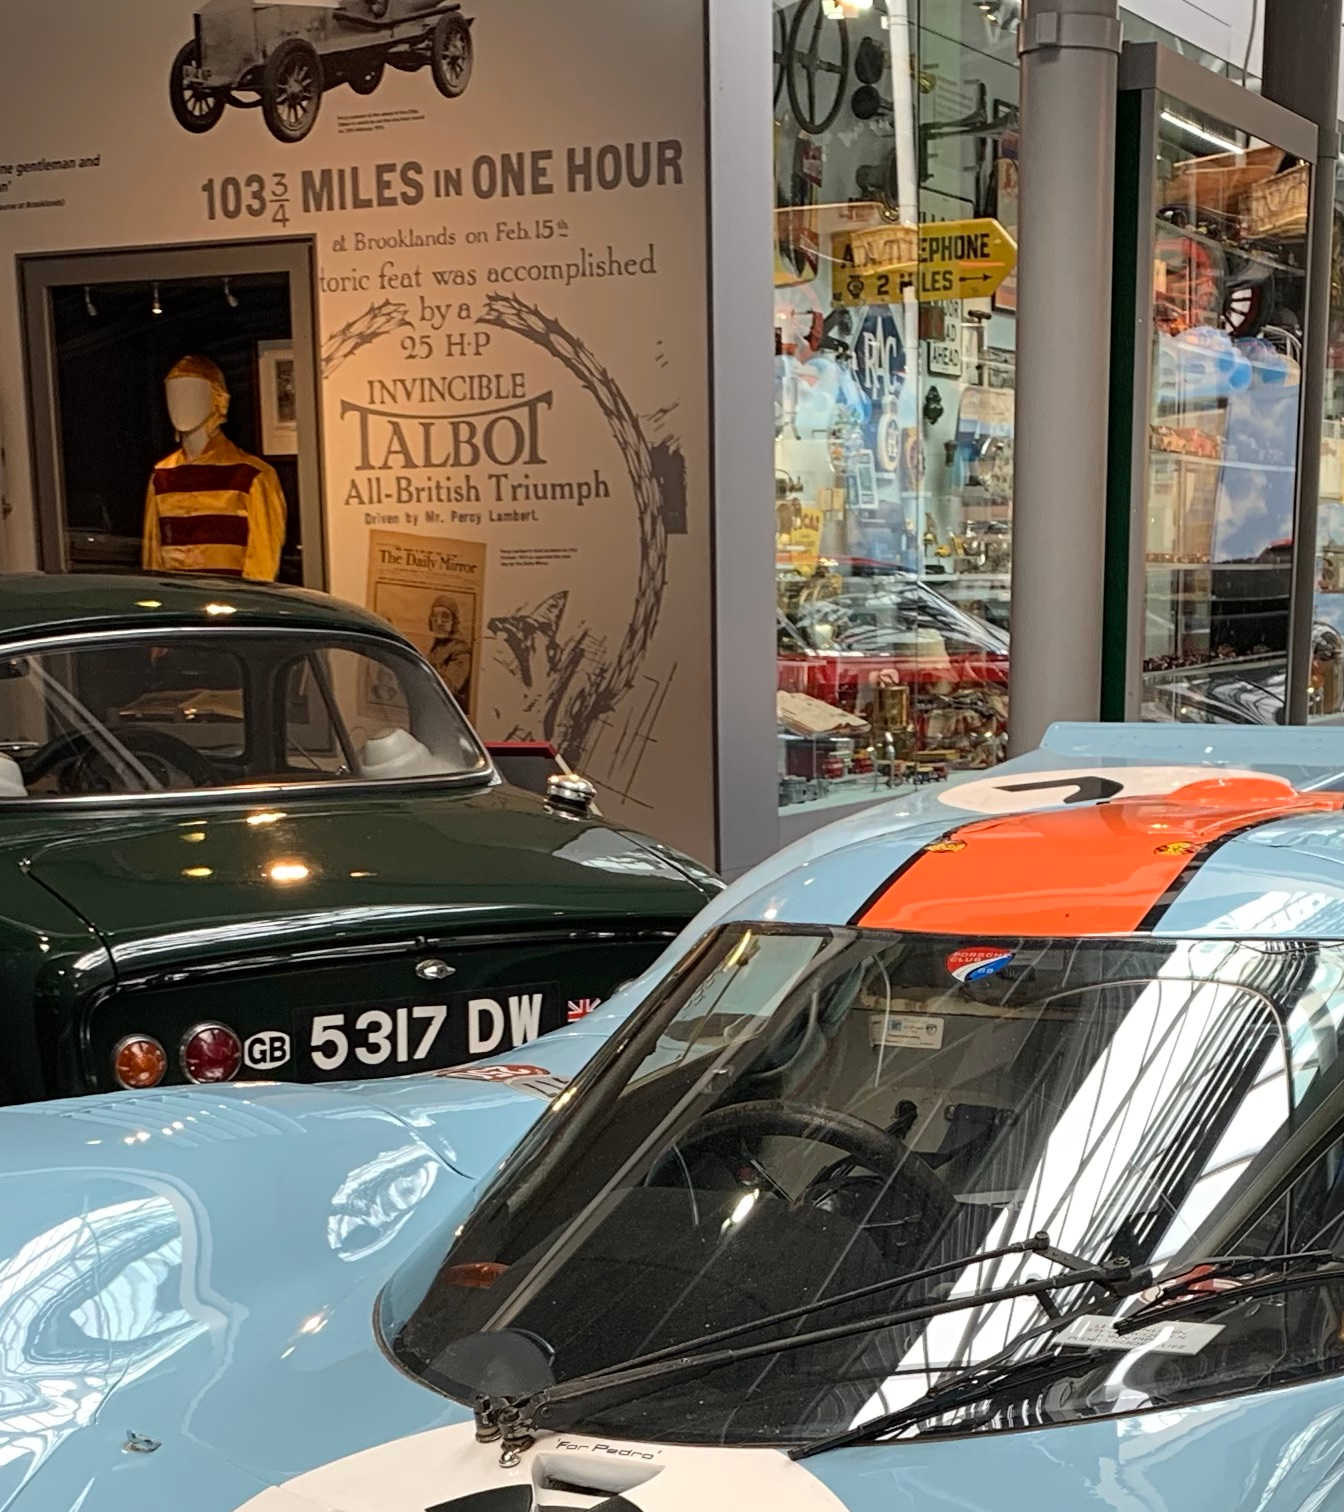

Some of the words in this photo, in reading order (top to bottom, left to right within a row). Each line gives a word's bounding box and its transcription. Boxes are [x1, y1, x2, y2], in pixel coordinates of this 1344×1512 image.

[16, 158, 76, 176] gentleman
[78, 154, 100, 167] and
[201, 175, 266, 220] 103
[302, 161, 424, 213] MILES
[434, 168, 462, 199] IN
[472, 150, 553, 198] ONE
[567, 139, 683, 191] HOUR
[355, 228, 455, 252] Brooklands
[465, 228, 488, 243] on
[320, 266, 370, 294] toric
[378, 262, 422, 290] feat
[431, 267, 476, 287] was
[487, 244, 656, 285] accomplished
[877, 275, 889, 296] 2
[419, 301, 448, 329] by
[457, 306, 471, 321] a
[400, 335, 433, 360] 25
[367, 373, 526, 404] INVINCIBLE
[340, 390, 553, 471] TALBOT
[344, 474, 480, 506] All-British
[488, 470, 610, 505] Triumph
[364, 513, 400, 525] Driven
[405, 512, 419, 526] by
[451, 511, 482, 526] Percy
[379, 549, 402, 567] The
[405, 553, 436, 572] Daily
[310, 1005, 448, 1071] 5317
[468, 993, 544, 1054] DW
[249, 1035, 288, 1064] GB
